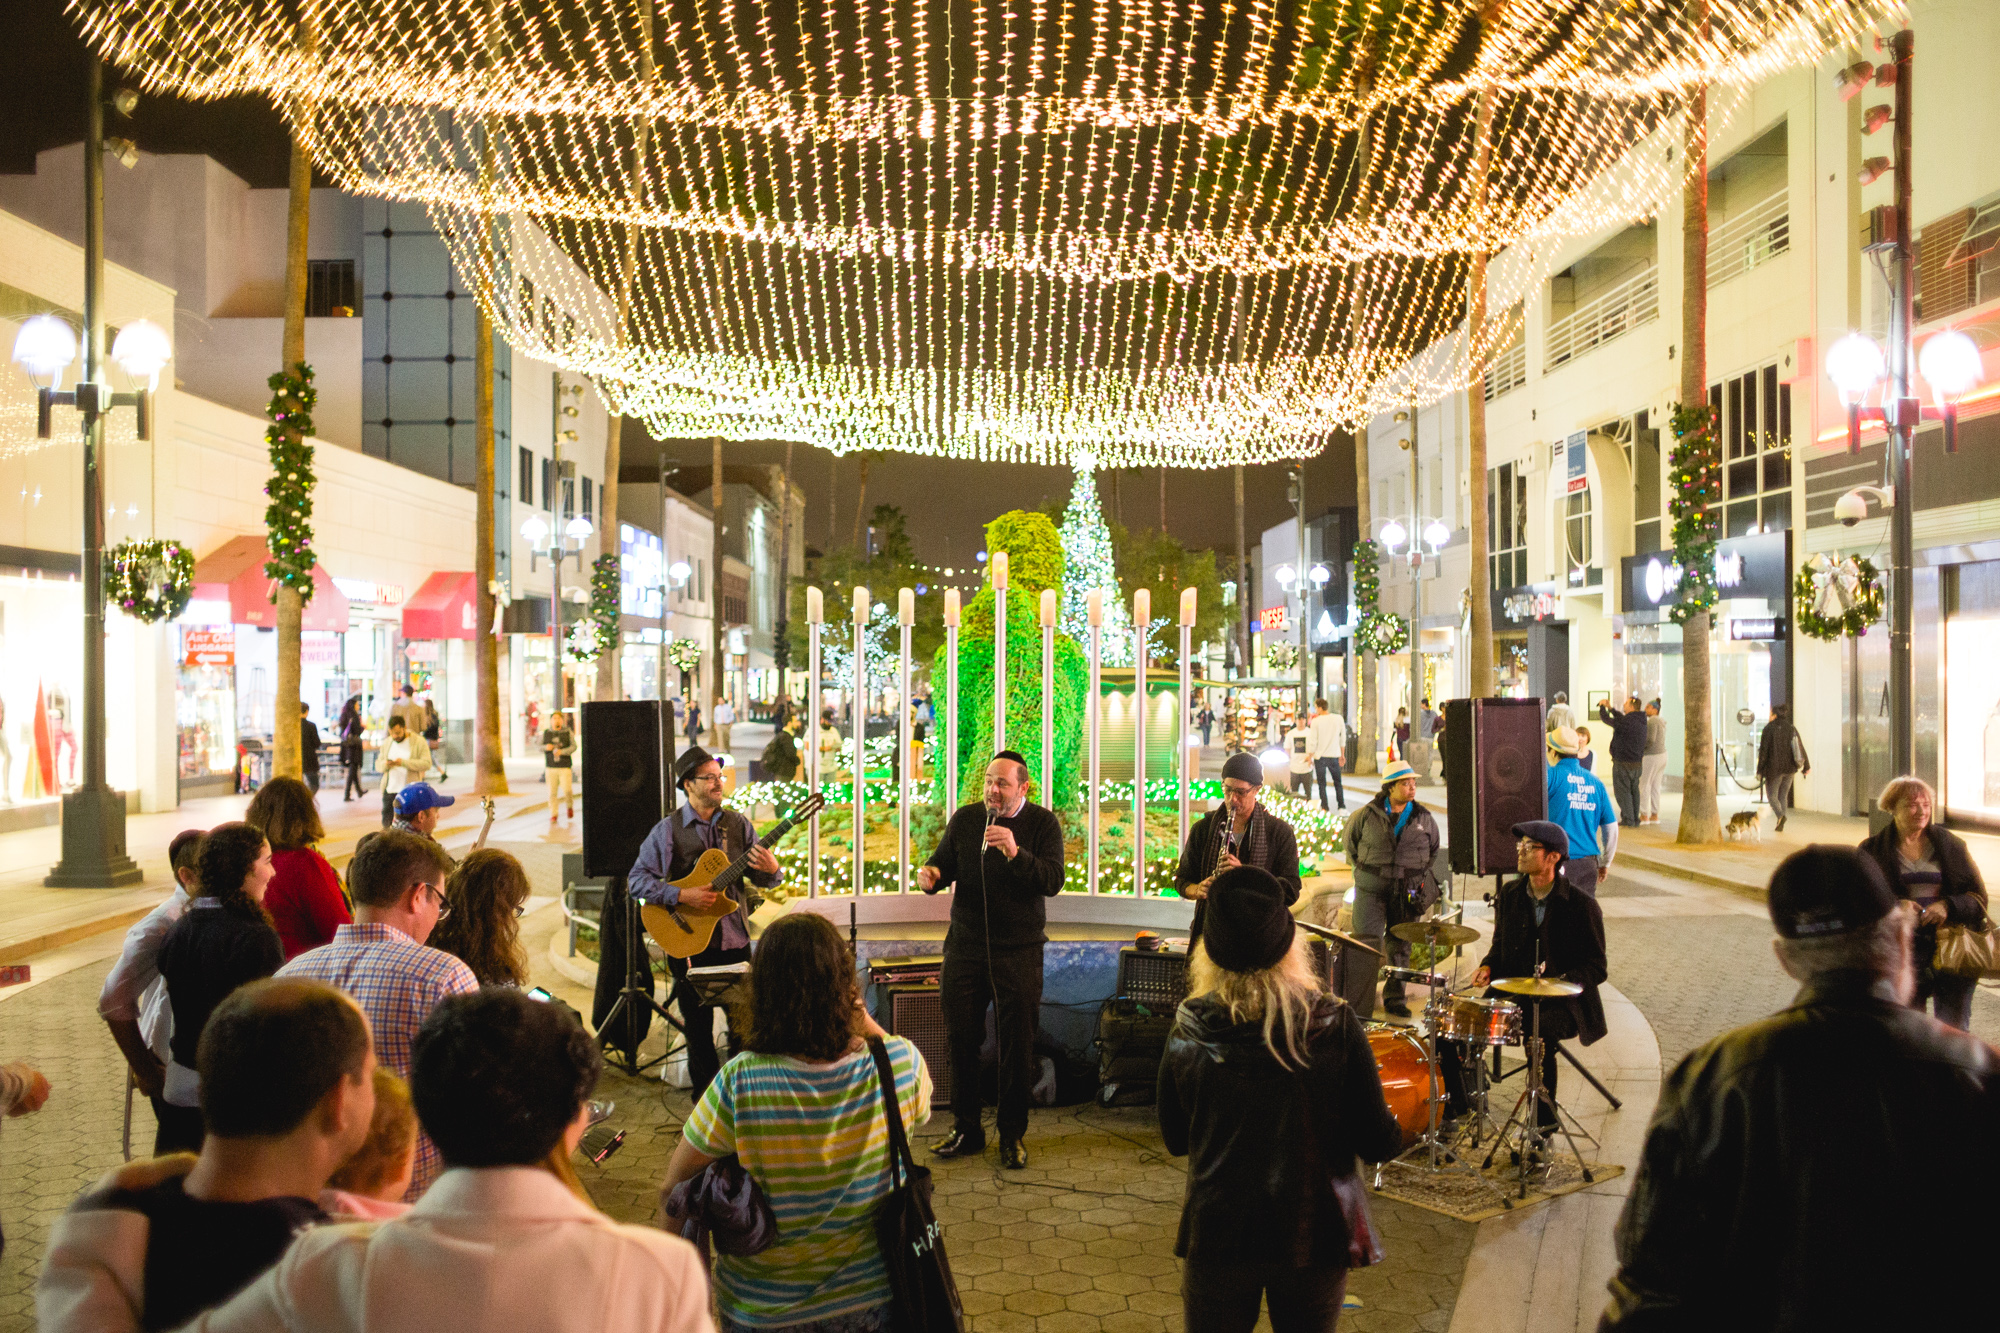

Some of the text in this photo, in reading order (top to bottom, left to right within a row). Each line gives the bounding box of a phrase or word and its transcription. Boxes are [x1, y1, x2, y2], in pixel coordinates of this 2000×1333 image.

[186, 643, 235, 653] LUGGAGE
[301, 650, 339, 662] EWELRY
[1567, 792, 1588, 802] santa
[1570, 801, 1597, 811] monica
